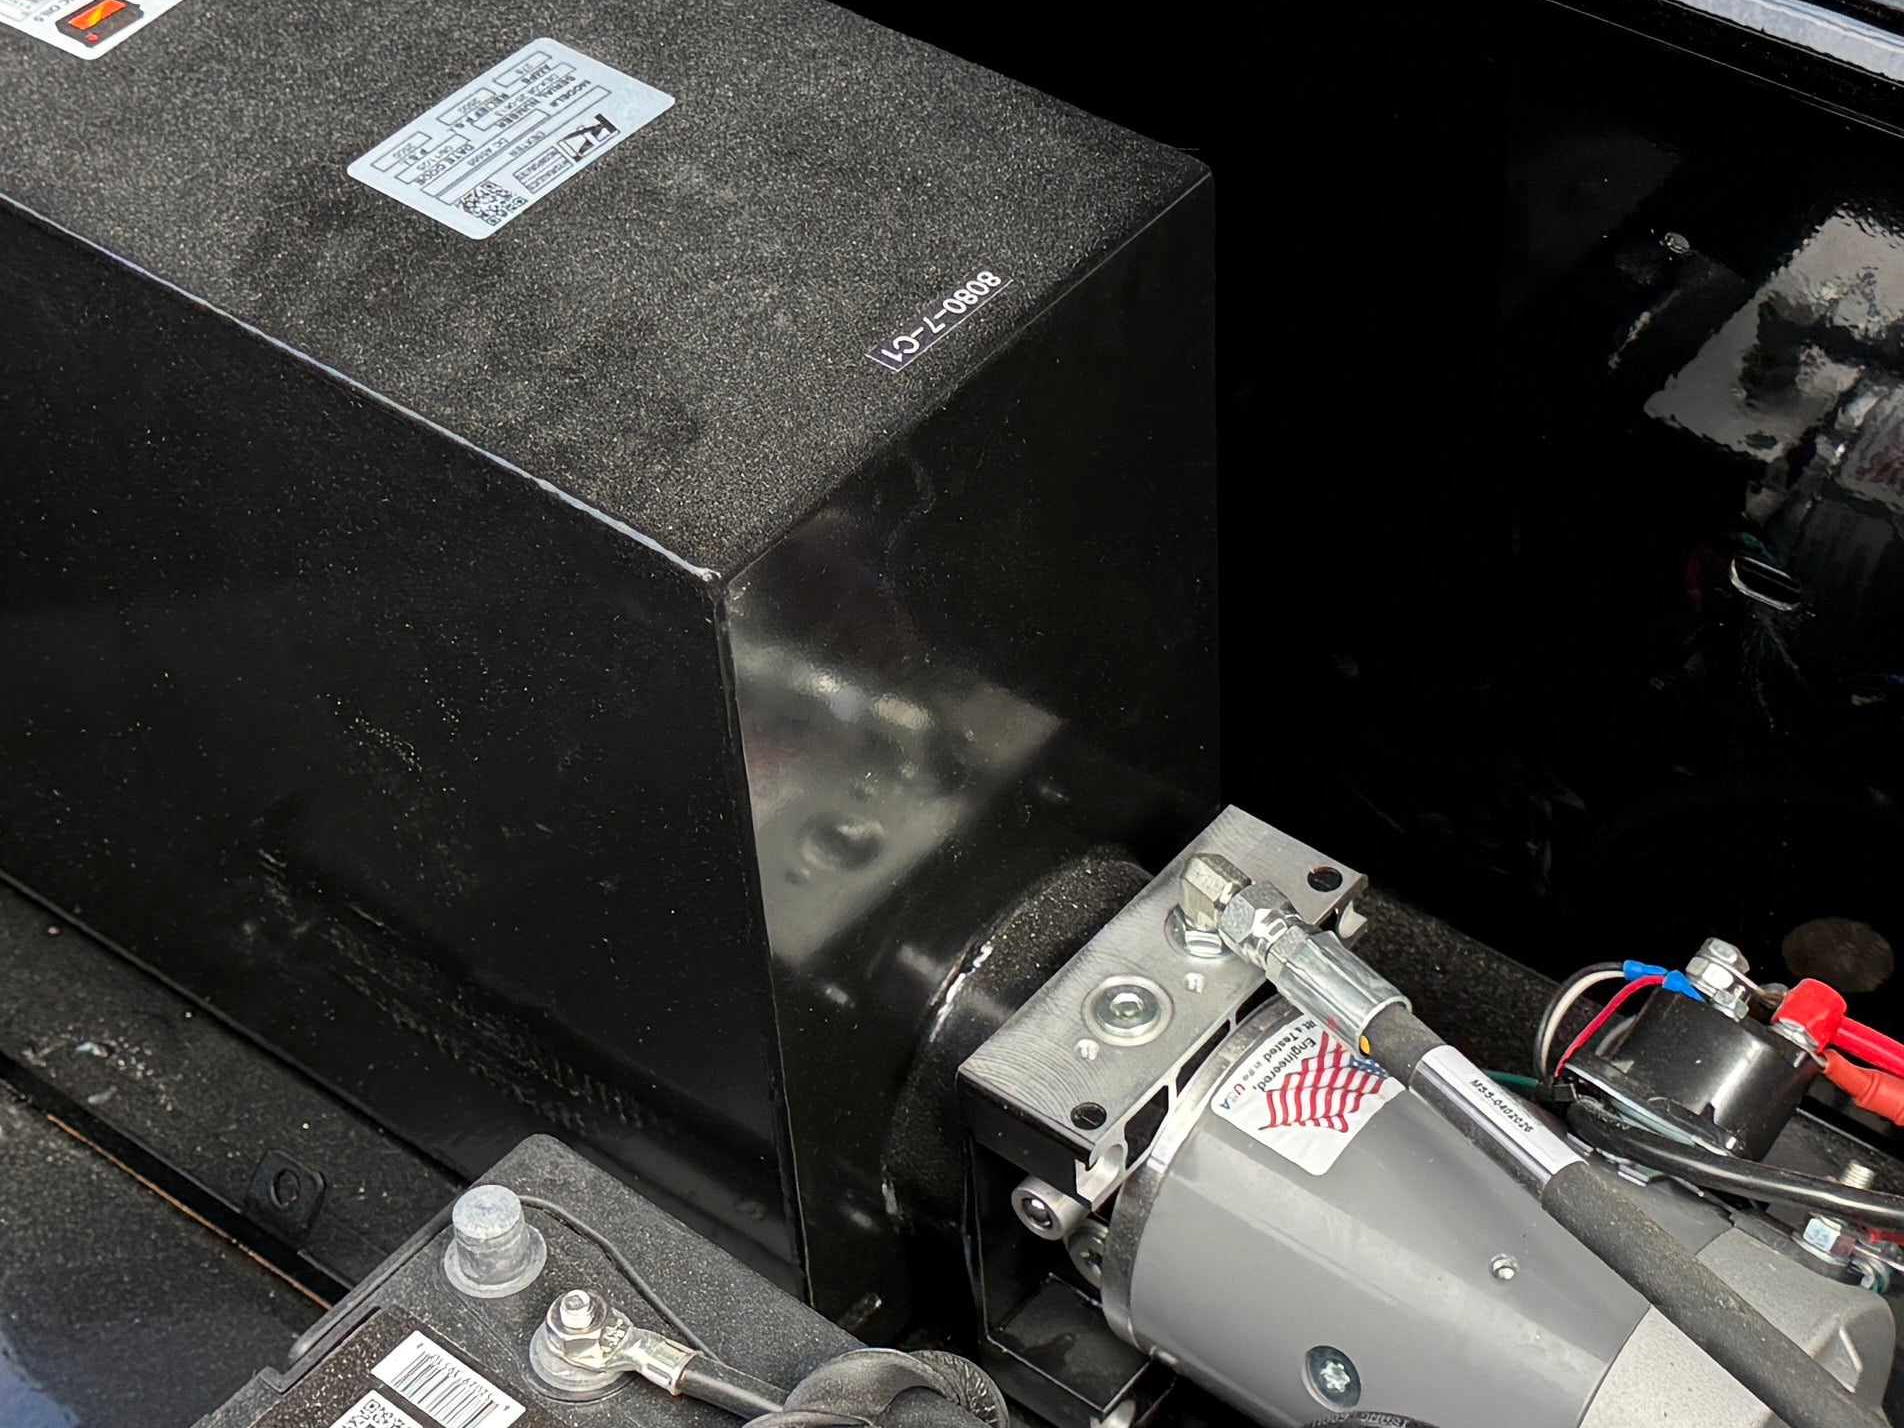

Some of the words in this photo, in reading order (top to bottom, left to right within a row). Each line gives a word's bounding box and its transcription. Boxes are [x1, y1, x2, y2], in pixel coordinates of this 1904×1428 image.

[30, 3, 63, 23] OILS
[538, 74, 576, 99] SERIAL
[495, 98, 542, 129] NUMBER
[440, 143, 475, 166] DATE
[506, 130, 546, 157] DEXTER
[411, 162, 447, 185] CODE
[877, 270, 1009, 365] 8080-7-C1
[1263, 1031, 1299, 1062] Tested
[1251, 1035, 1316, 1095] Engineered,
[1219, 1082, 1246, 1111] USA
